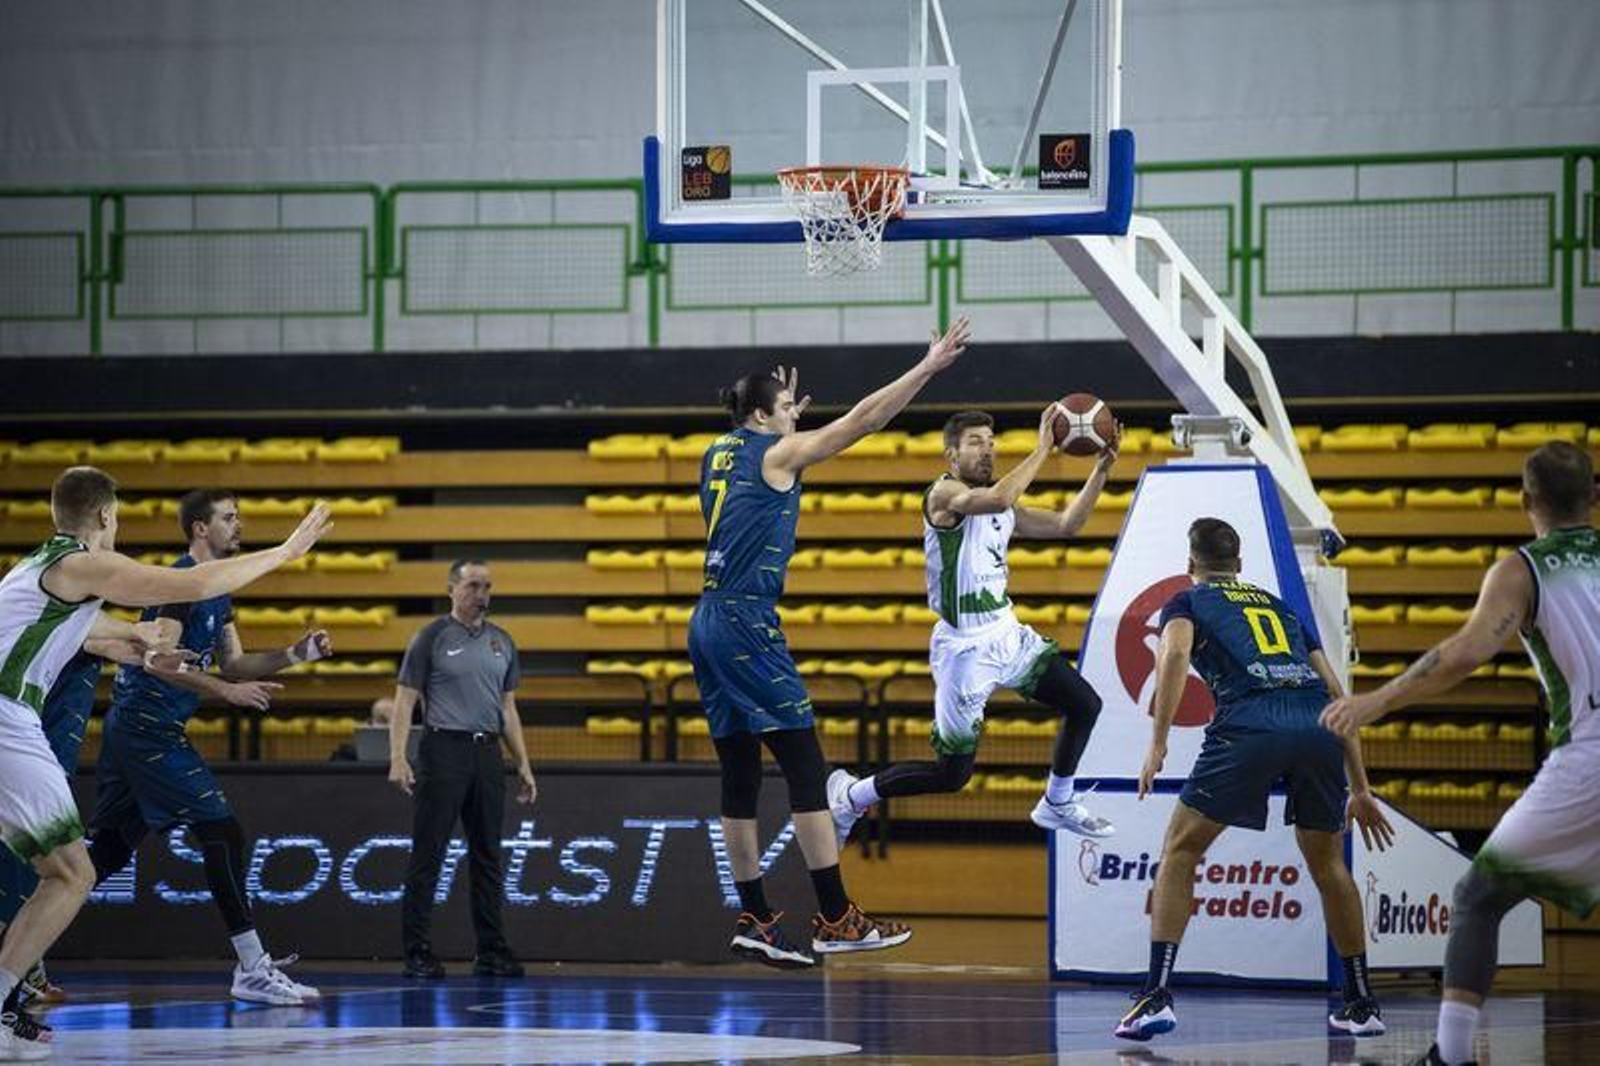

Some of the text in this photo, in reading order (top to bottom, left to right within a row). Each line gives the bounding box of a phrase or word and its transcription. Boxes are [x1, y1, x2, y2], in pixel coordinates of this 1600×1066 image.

[685, 172, 712, 185] LEB
[707, 479, 728, 542] 7
[1242, 606, 1292, 655] 0
[1144, 889, 1302, 920] radelo
[1378, 890, 1453, 935] BricoCe
